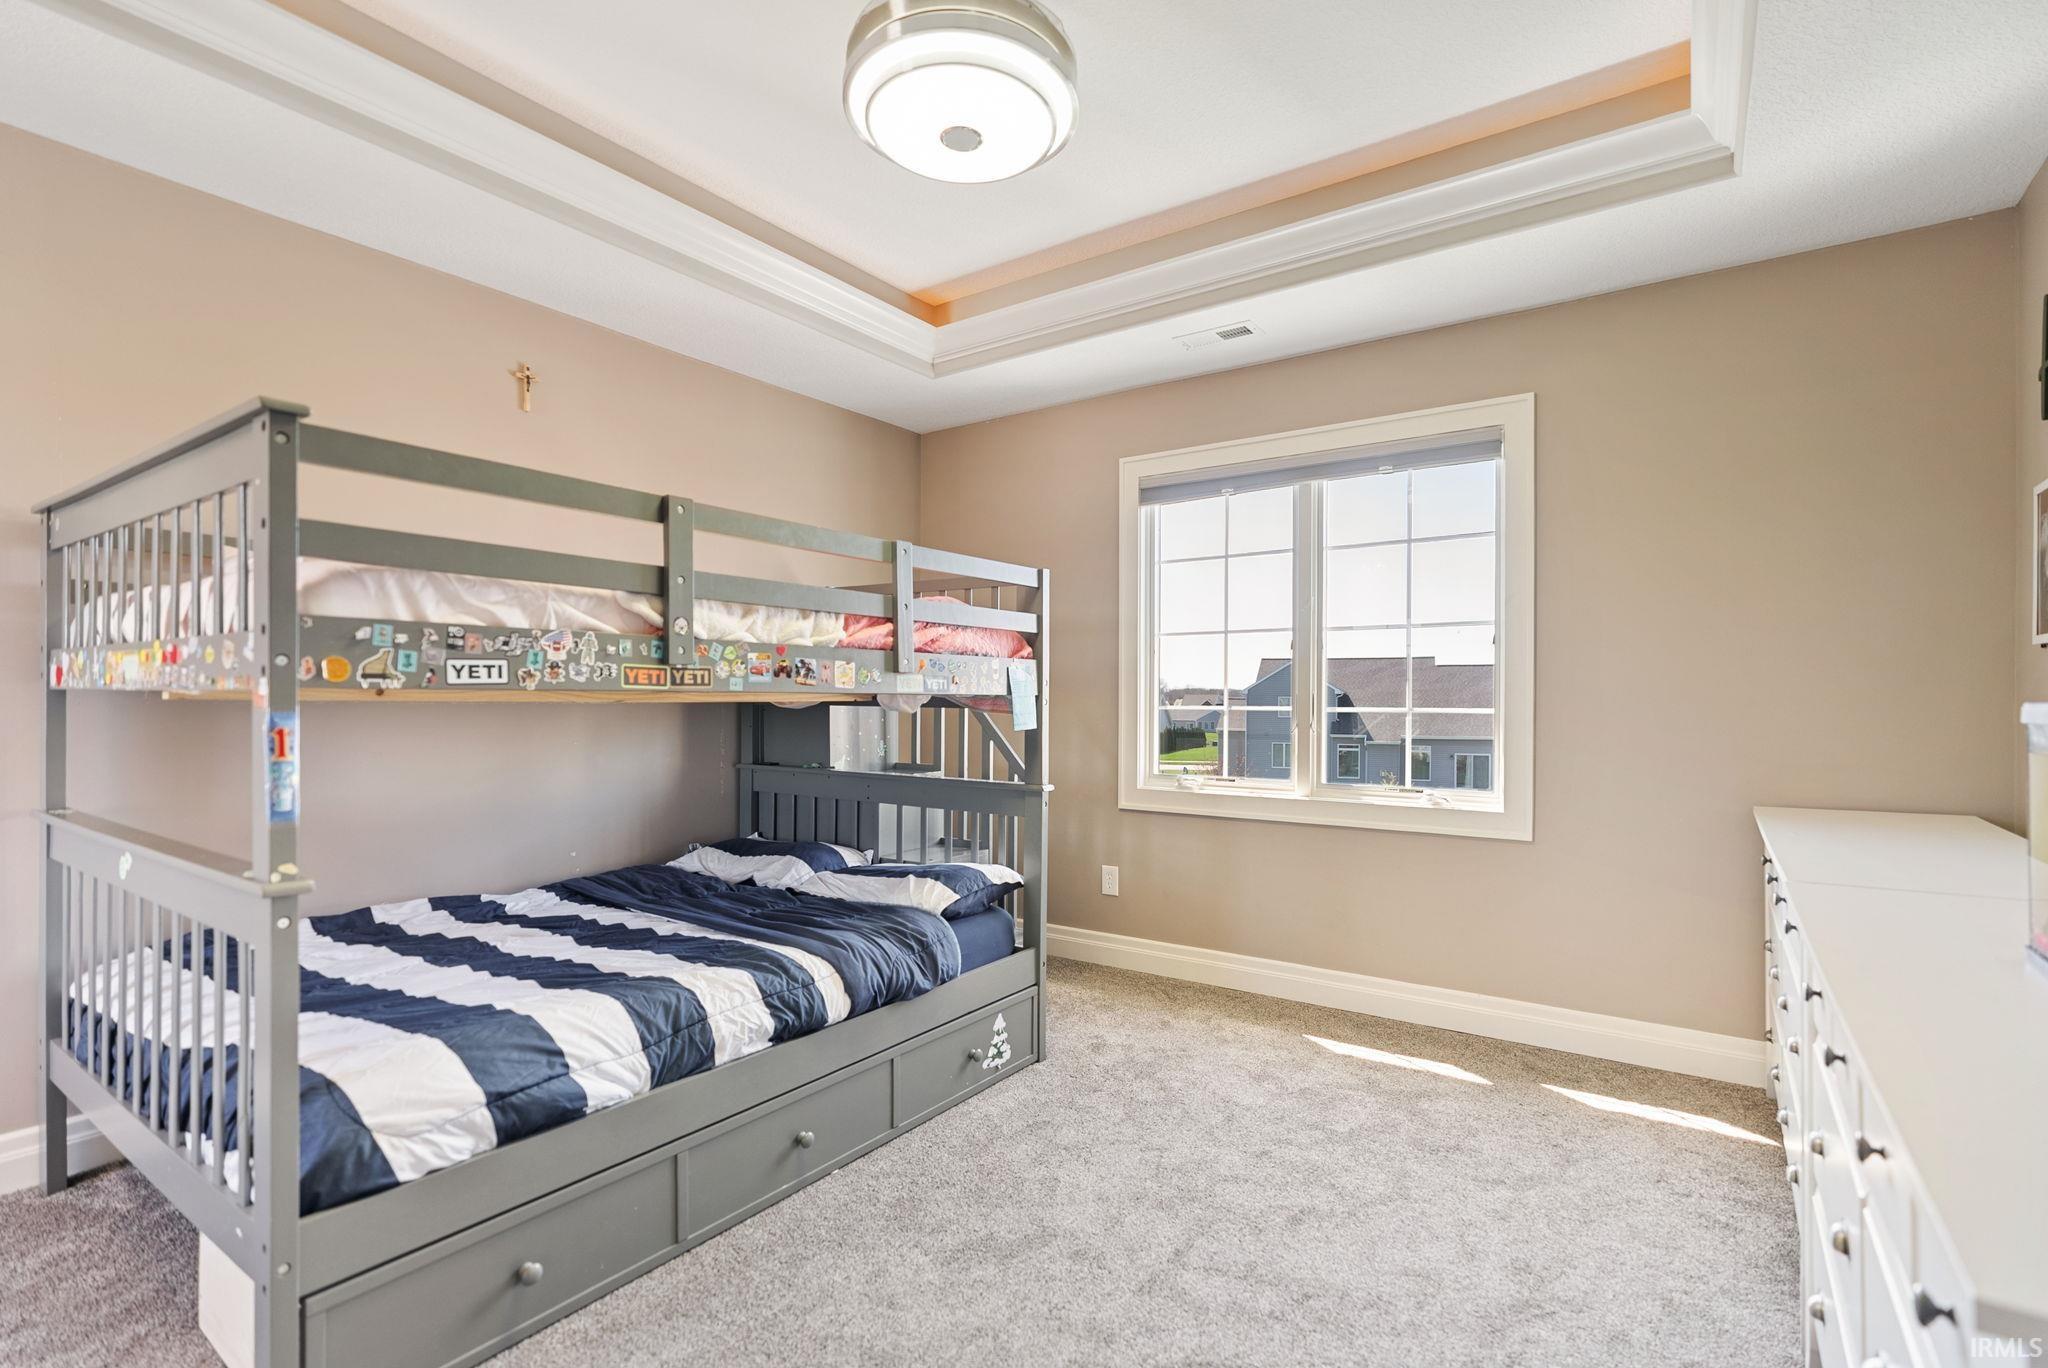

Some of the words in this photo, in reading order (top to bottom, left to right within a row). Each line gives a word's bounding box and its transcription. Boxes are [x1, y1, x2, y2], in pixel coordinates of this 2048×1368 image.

[451, 664, 503, 679] YETI
[625, 668, 665, 684] YETI
[672, 670, 709, 684] YETI
[926, 678, 948, 690] YETI
[273, 727, 292, 761] 1
